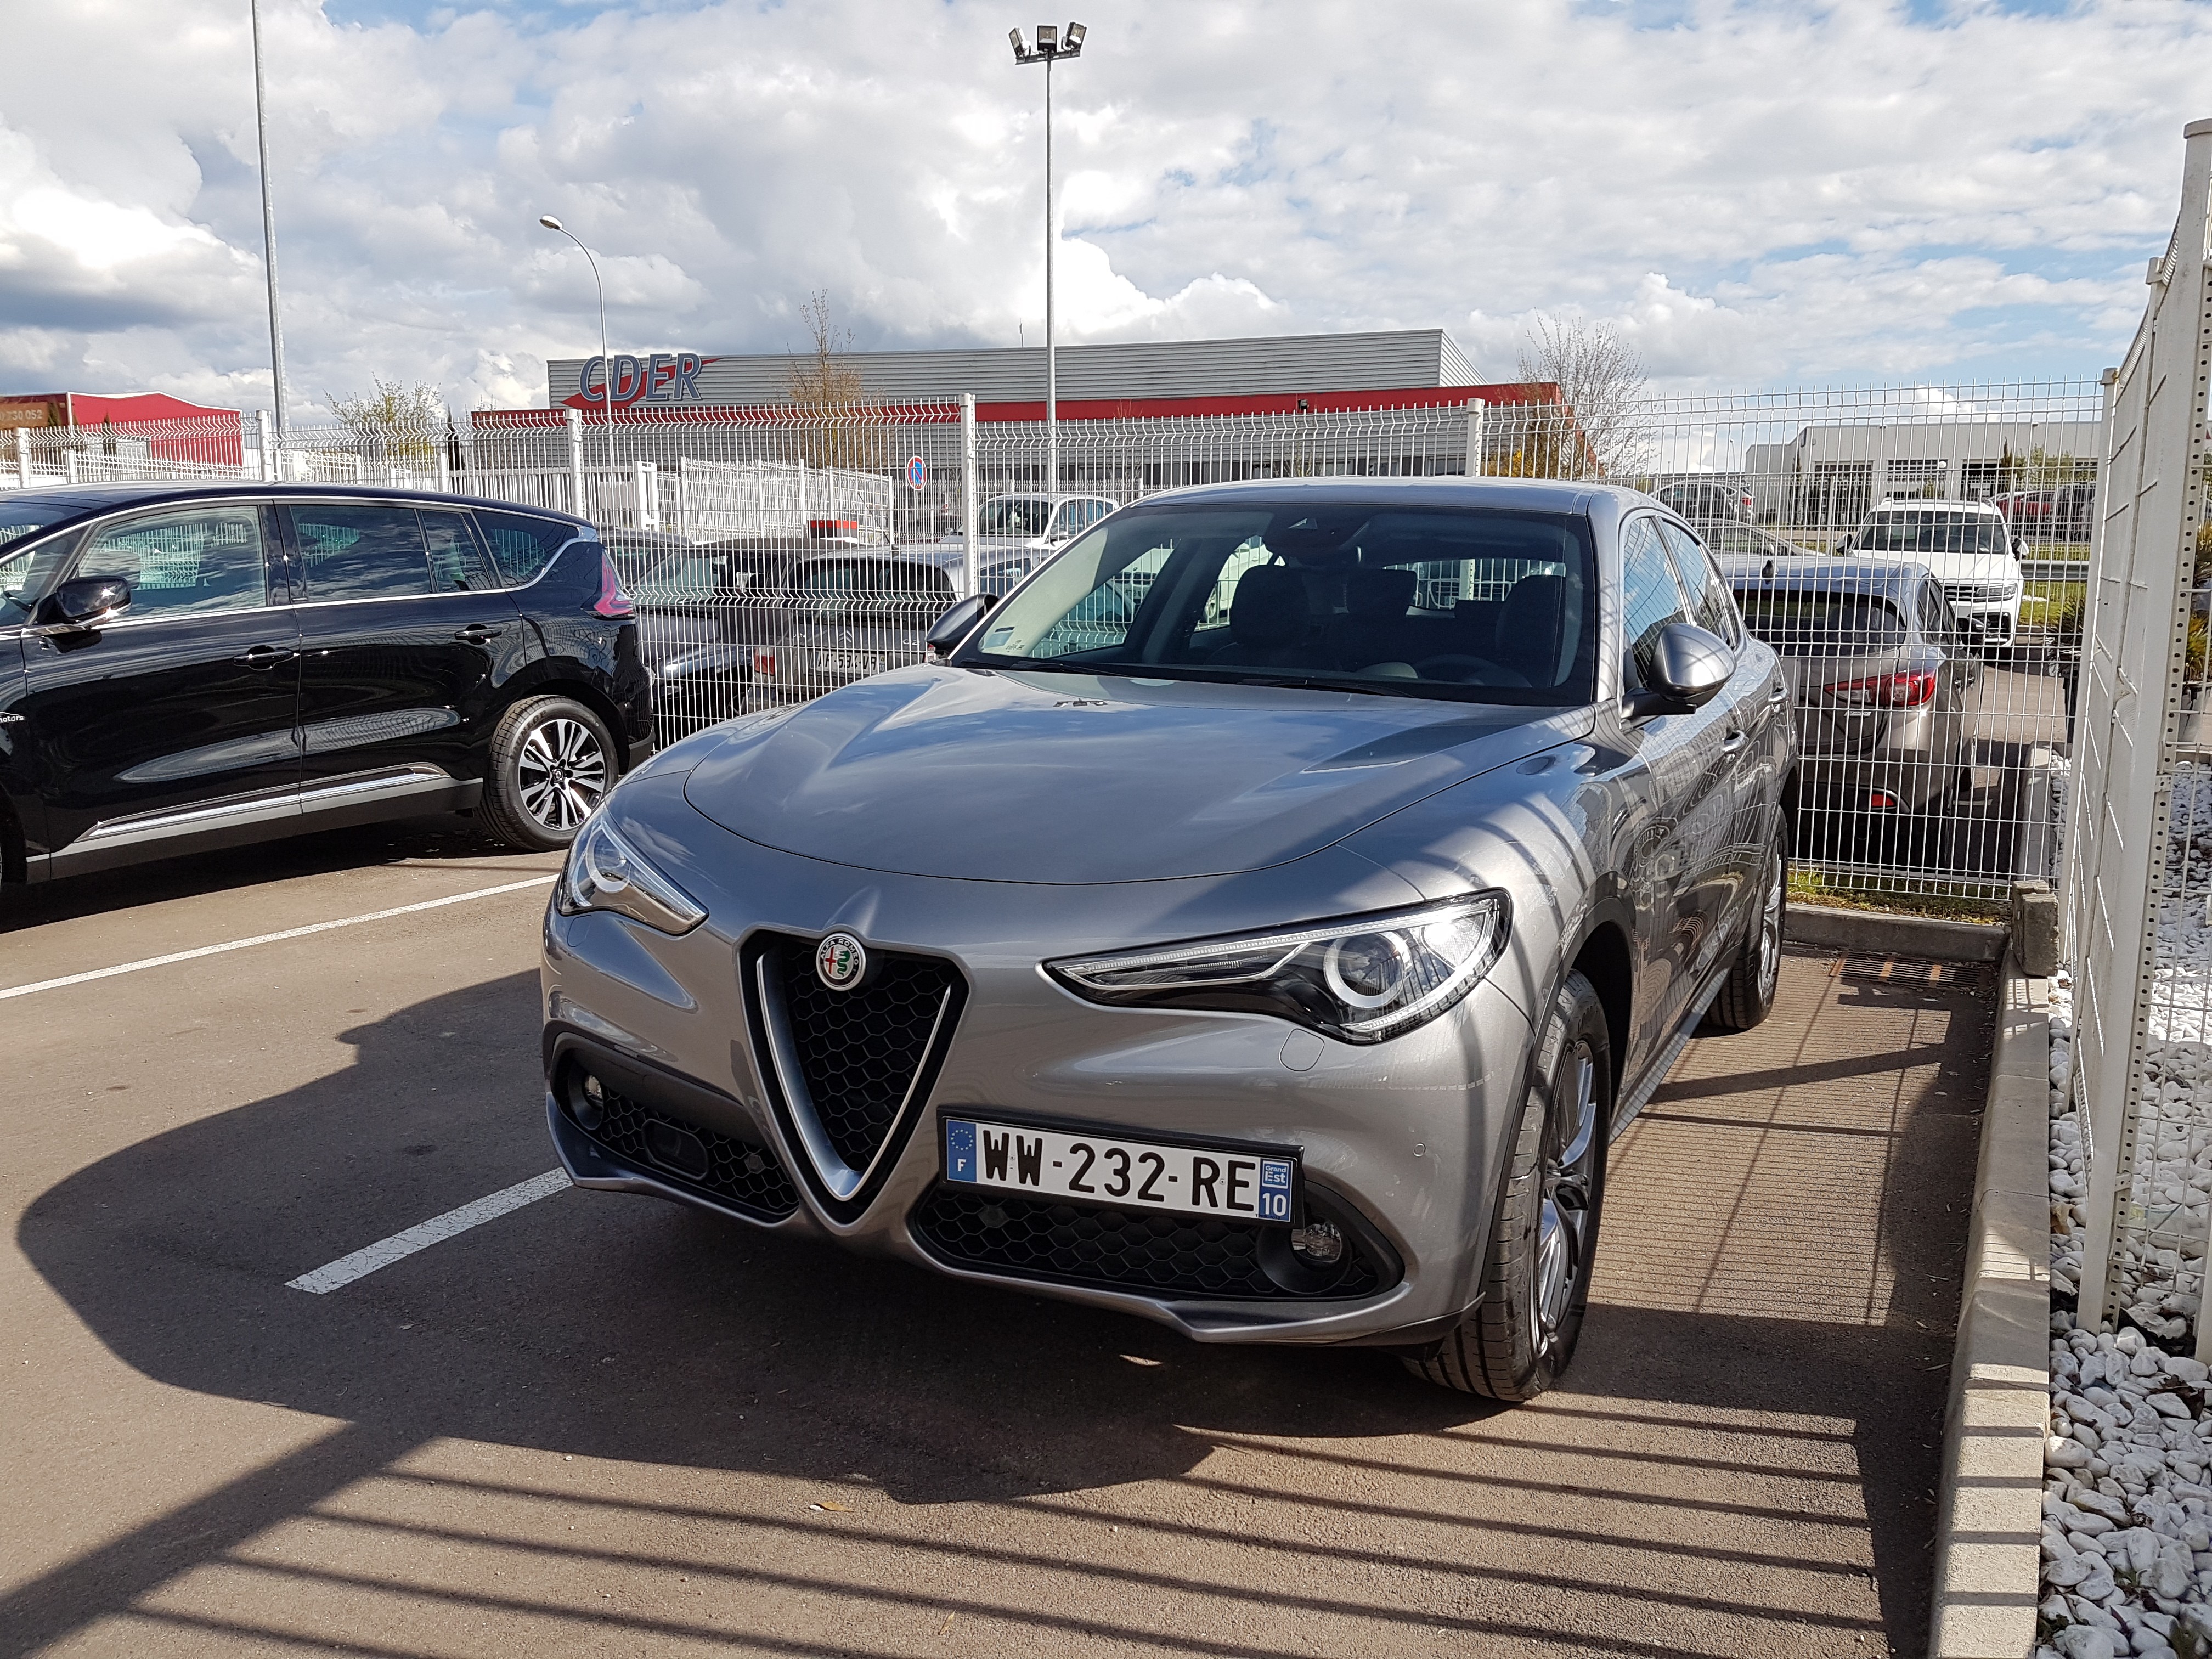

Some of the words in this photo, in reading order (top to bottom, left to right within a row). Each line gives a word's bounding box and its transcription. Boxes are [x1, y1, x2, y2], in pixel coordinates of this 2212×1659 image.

[579, 353, 703, 402] CDER
[25, 409, 42, 420] 052
[821, 940, 835, 959] ALFA
[838, 939, 859, 966] ROMEO
[957, 1158, 967, 1172] F
[983, 1130, 1256, 1212] WW-232-RE
[1265, 1171, 1286, 1183] Est
[1262, 1193, 1286, 1216] 10
